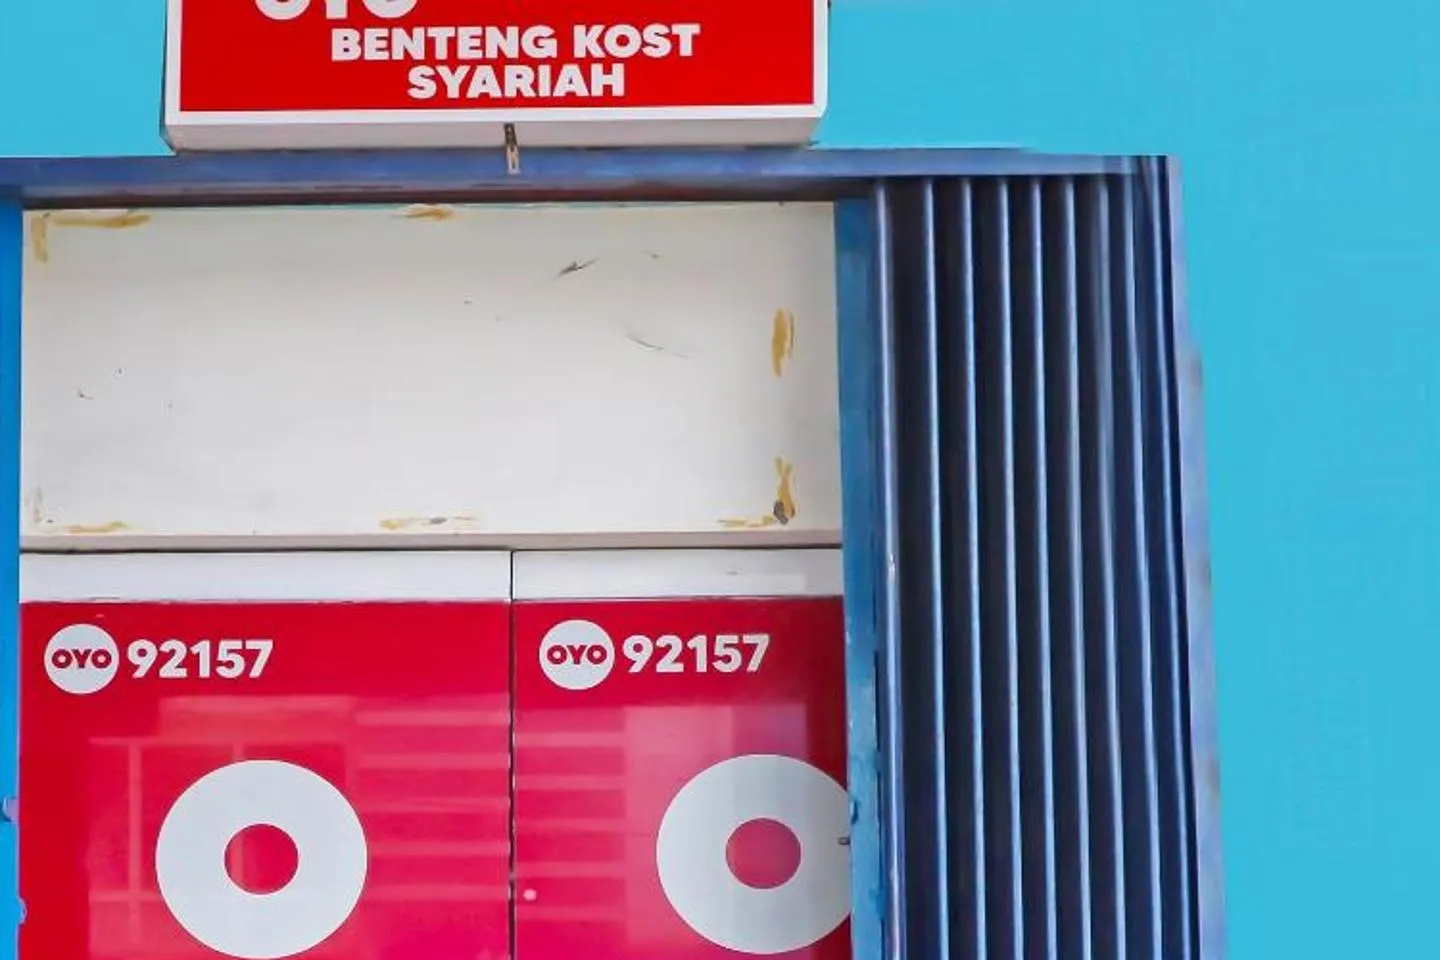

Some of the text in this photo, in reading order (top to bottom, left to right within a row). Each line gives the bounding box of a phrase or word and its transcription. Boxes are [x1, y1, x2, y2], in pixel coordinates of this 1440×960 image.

[332, 24, 700, 60] BENTENG KOST
[408, 63, 624, 98] SYARIAH
[52, 640, 273, 678] OYO 92157
[547, 634, 769, 672] OYO 92157
